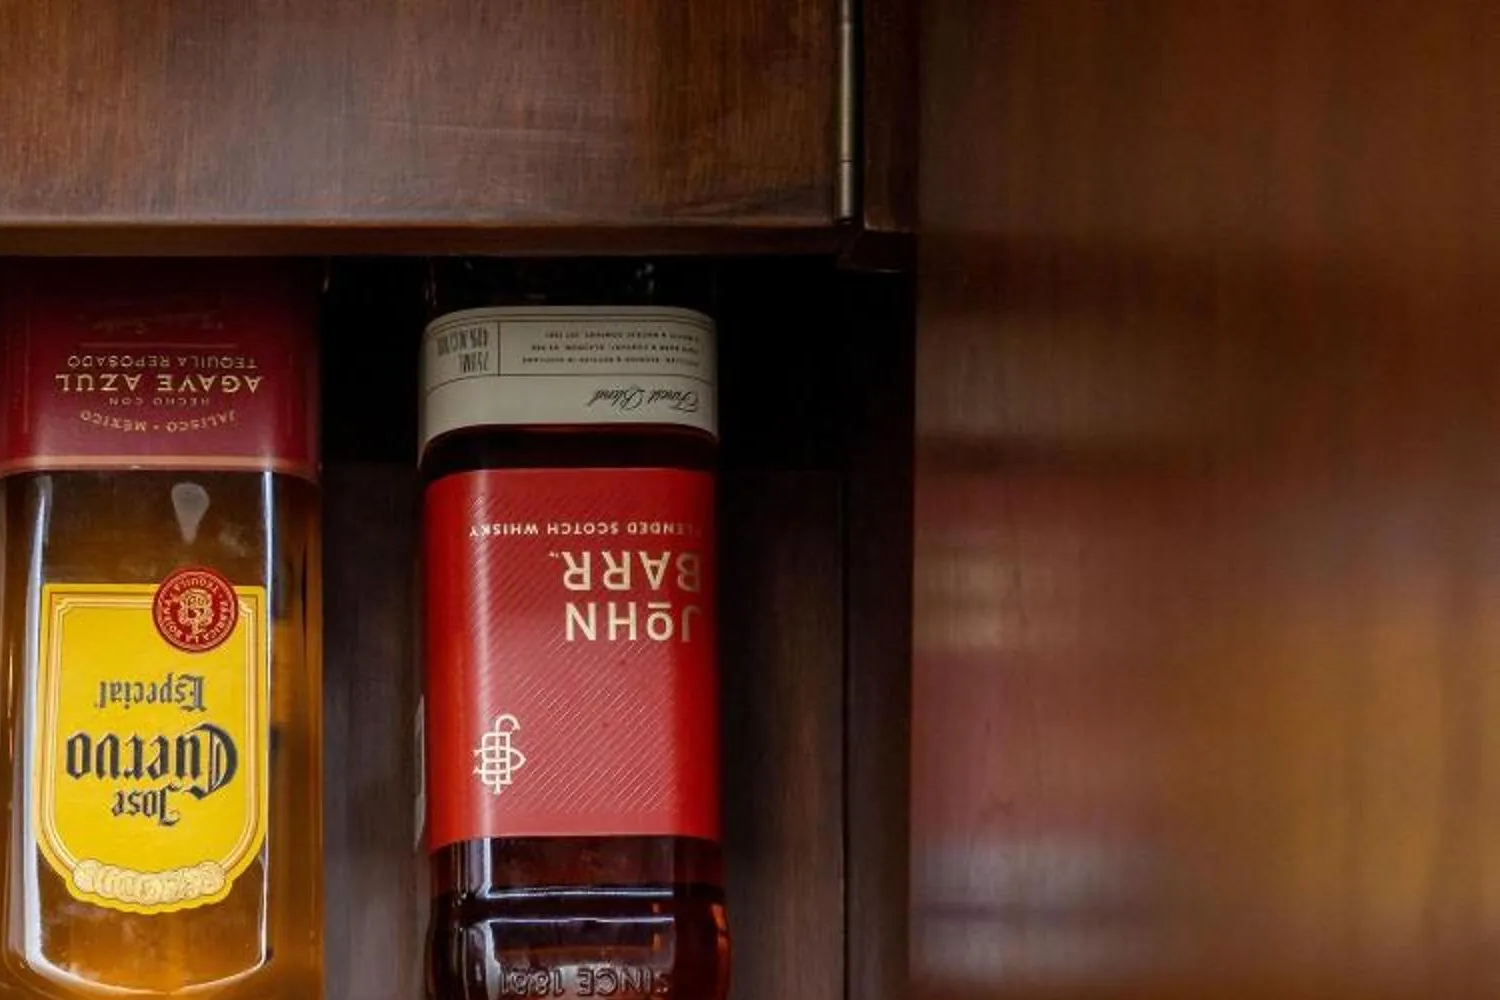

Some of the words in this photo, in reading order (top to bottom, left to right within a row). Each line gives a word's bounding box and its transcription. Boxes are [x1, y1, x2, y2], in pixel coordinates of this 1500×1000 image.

[66, 354, 171, 369] REPOSADO
[177, 354, 258, 370] TEQUILA
[54, 373, 143, 393] AZUL
[156, 373, 263, 393] AGAVE
[108, 397, 143, 406] CON
[152, 397, 210, 406] HECHO
[586, 388, 645, 412] Blend
[647, 389, 699, 413] Finest
[166, 409, 236, 433] JALISCO
[469, 522, 539, 537] WHISKY
[547, 521, 619, 535] SCOTCH
[561, 551, 700, 592] BARR
[564, 601, 700, 642] JOHN
[98, 673, 207, 713] Especial
[66, 723, 238, 800] Cuervo
[111, 784, 181, 827] Jose
[577, 967, 670, 997] SINCE
